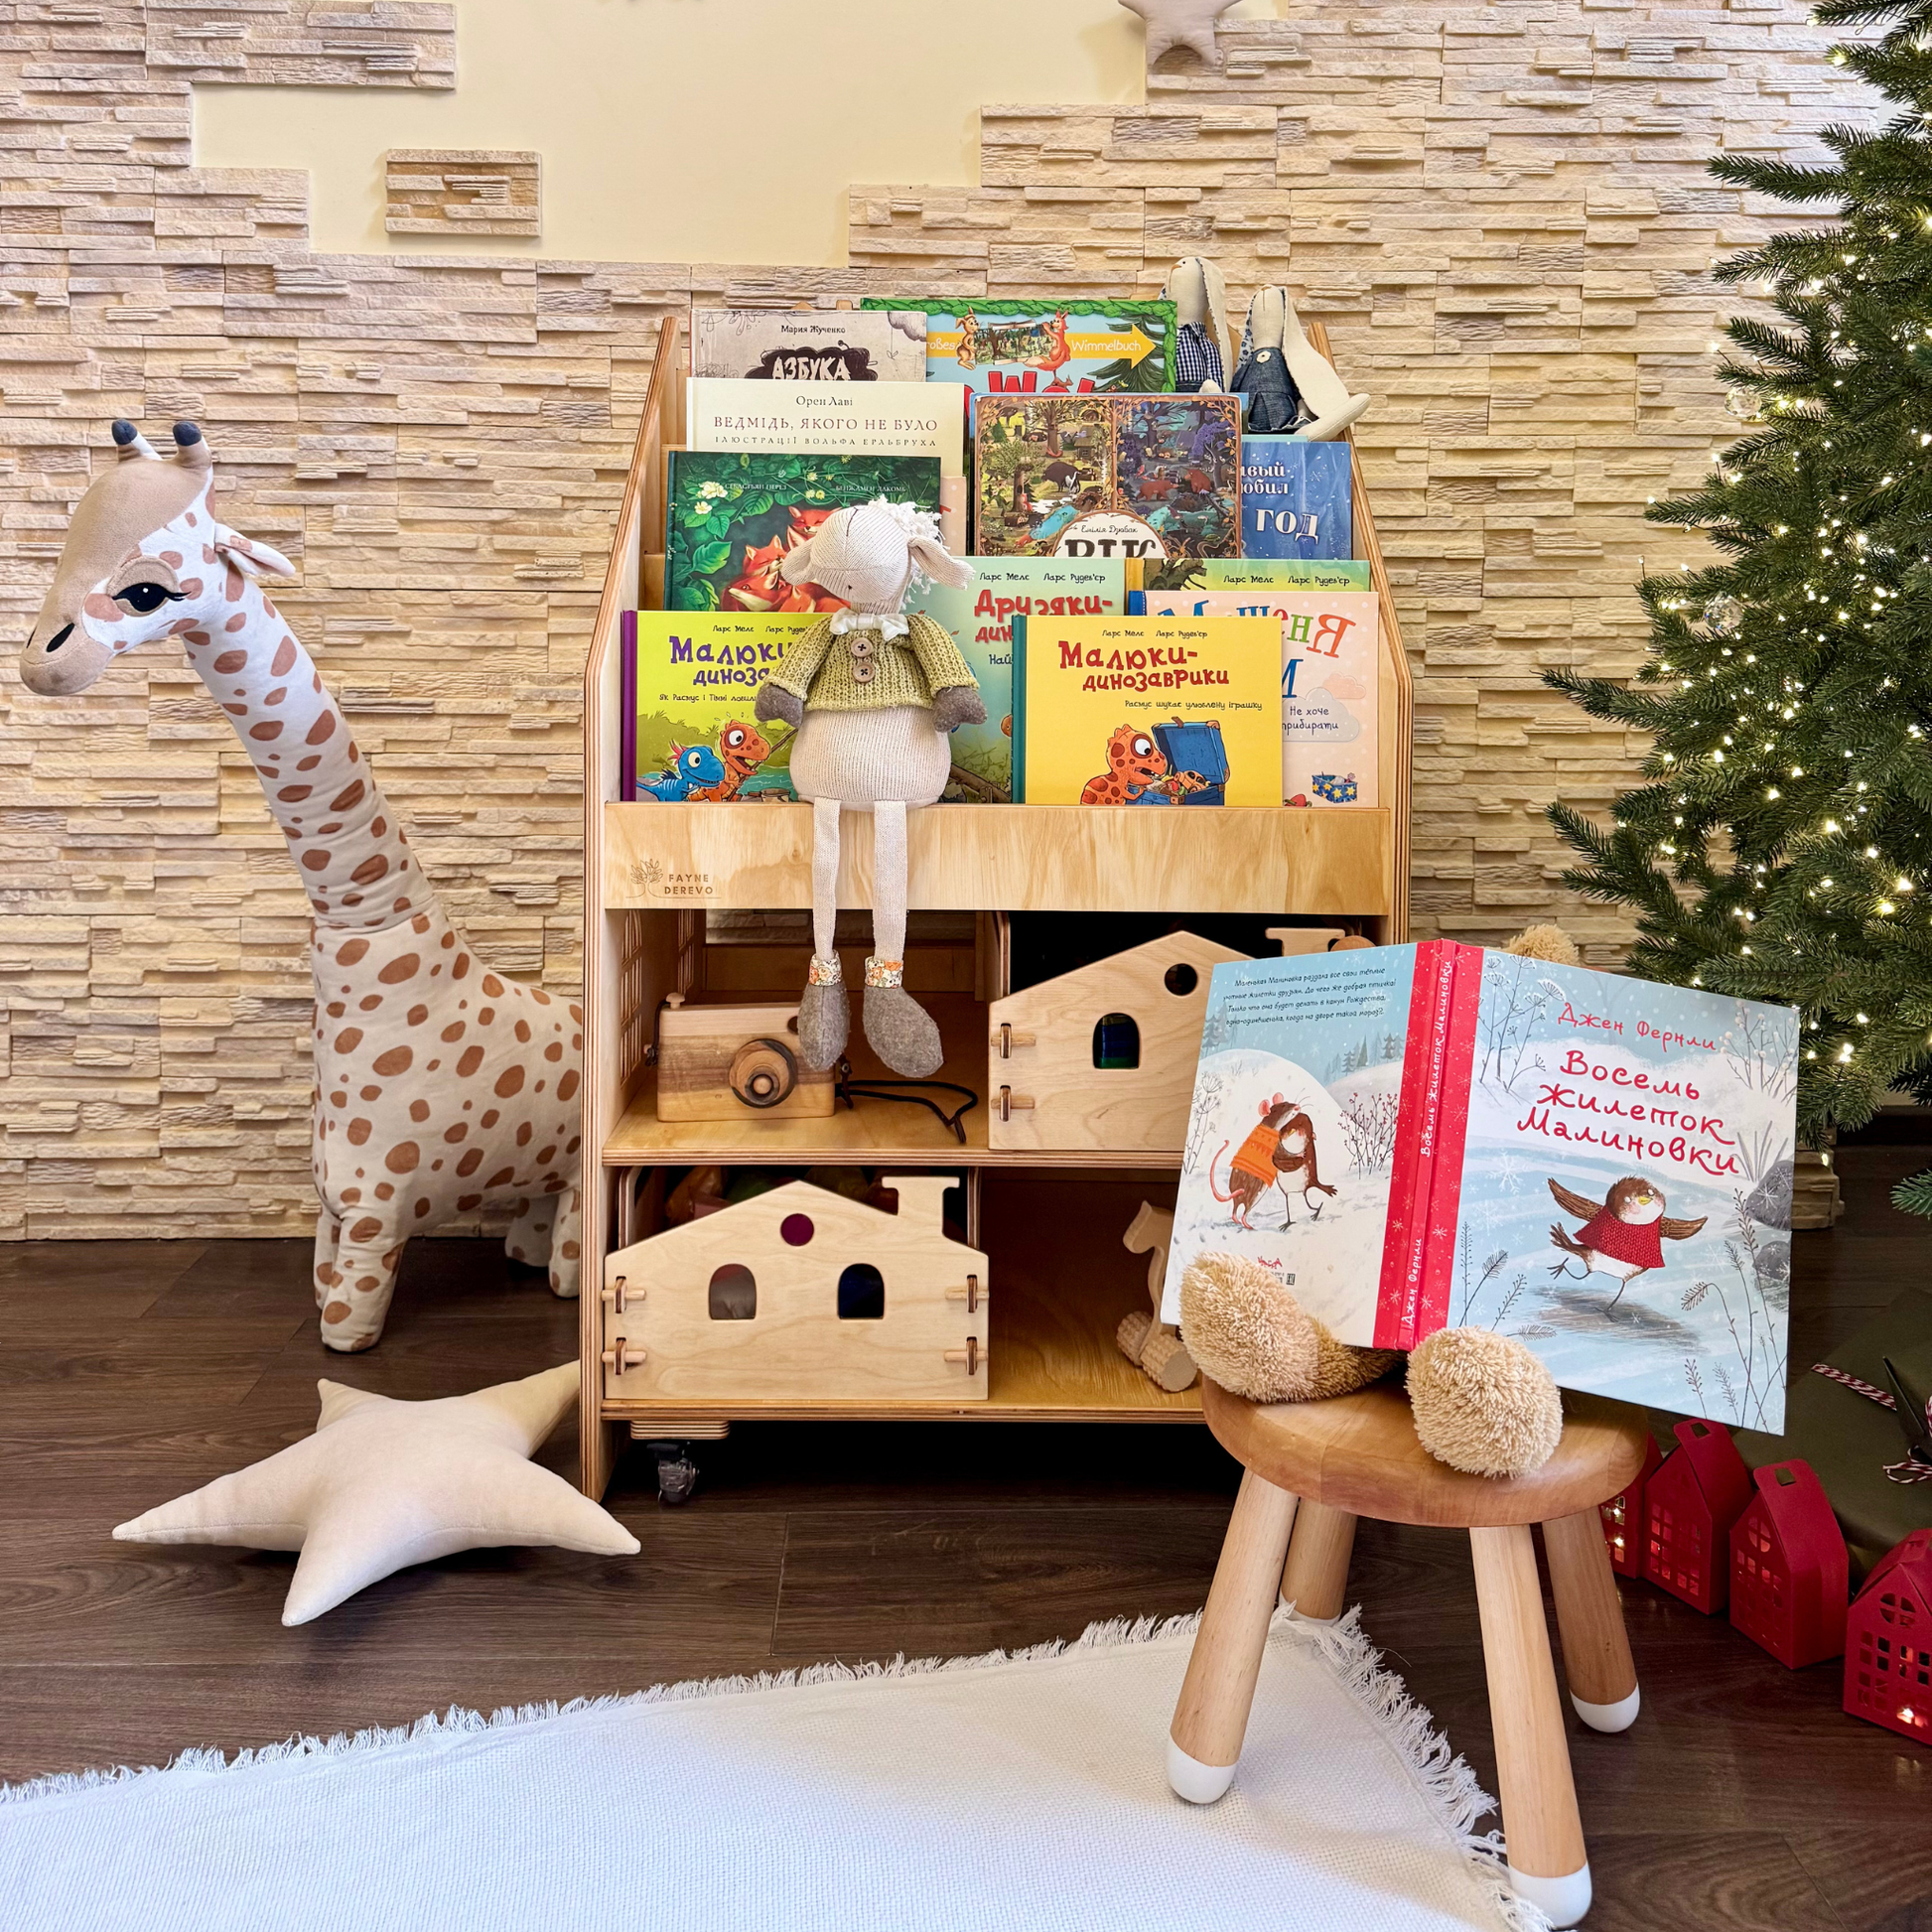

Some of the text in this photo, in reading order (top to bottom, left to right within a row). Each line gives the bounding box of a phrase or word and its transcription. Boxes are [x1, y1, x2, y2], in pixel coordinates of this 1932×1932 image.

[781, 325, 846, 336] Мария Жученко
[1070, 340, 1142, 352] Wimmelbuch
[771, 356, 852, 381] АЗБУКА
[795, 395, 854, 408] Орен Лаві
[714, 416, 939, 432] ВЕДМІДЬ, ЯКОГО НЕ БУЛО
[715, 435, 937, 448] ІЛЮСТРАЦІЇ ВОЛЬФА ЕРЛЬБРУХА
[979, 572, 1002, 583] Ларс
[1043, 572, 1066, 584] Ларс
[1223, 575, 1247, 586] Ларс
[1288, 575, 1311, 587] Ларс
[974, 589, 1113, 623] Друзяки-
[712, 624, 732, 634] Ларс
[765, 625, 784, 634] Ларс
[1102, 629, 1121, 638] Ларс
[1156, 629, 1174, 638] Ларс
[1058, 640, 1197, 671] Малюки-
[1082, 668, 1230, 692] динозаврики
[672, 693, 700, 703] Расмус
[1124, 699, 1263, 712] Расмус шукає улюблену іграшку
[1290, 705, 1329, 716] Не хоче
[668, 874, 710, 883] FAYNE
[664, 886, 714, 895] DEREVO
[1234, 978, 1267, 988] Маленькая
[1268, 975, 1304, 984] Малиновка
[1303, 973, 1328, 983] раздала
[1248, 991, 1277, 1000] жилетки
[1342, 982, 1367, 994] добрая
[1368, 978, 1397, 989] птичка!
[1274, 1001, 1295, 1012] будет
[1295, 1000, 1318, 1011] делать
[1325, 998, 1345, 1007] канун
[1285, 1014, 1304, 1024] когда
[1314, 1012, 1335, 1022] дворе
[1358, 1007, 1385, 1018] мороз?
[1557, 1001, 1718, 1053] Джен Фернли
[1420, 1107, 1436, 1159] Восемь
[1435, 960, 1452, 1036] Малиновки
[1560, 1049, 1701, 1101] Восемь
[1516, 1106, 1740, 1175] Малиновки
[1401, 1238, 1423, 1326] Джен Фернли
